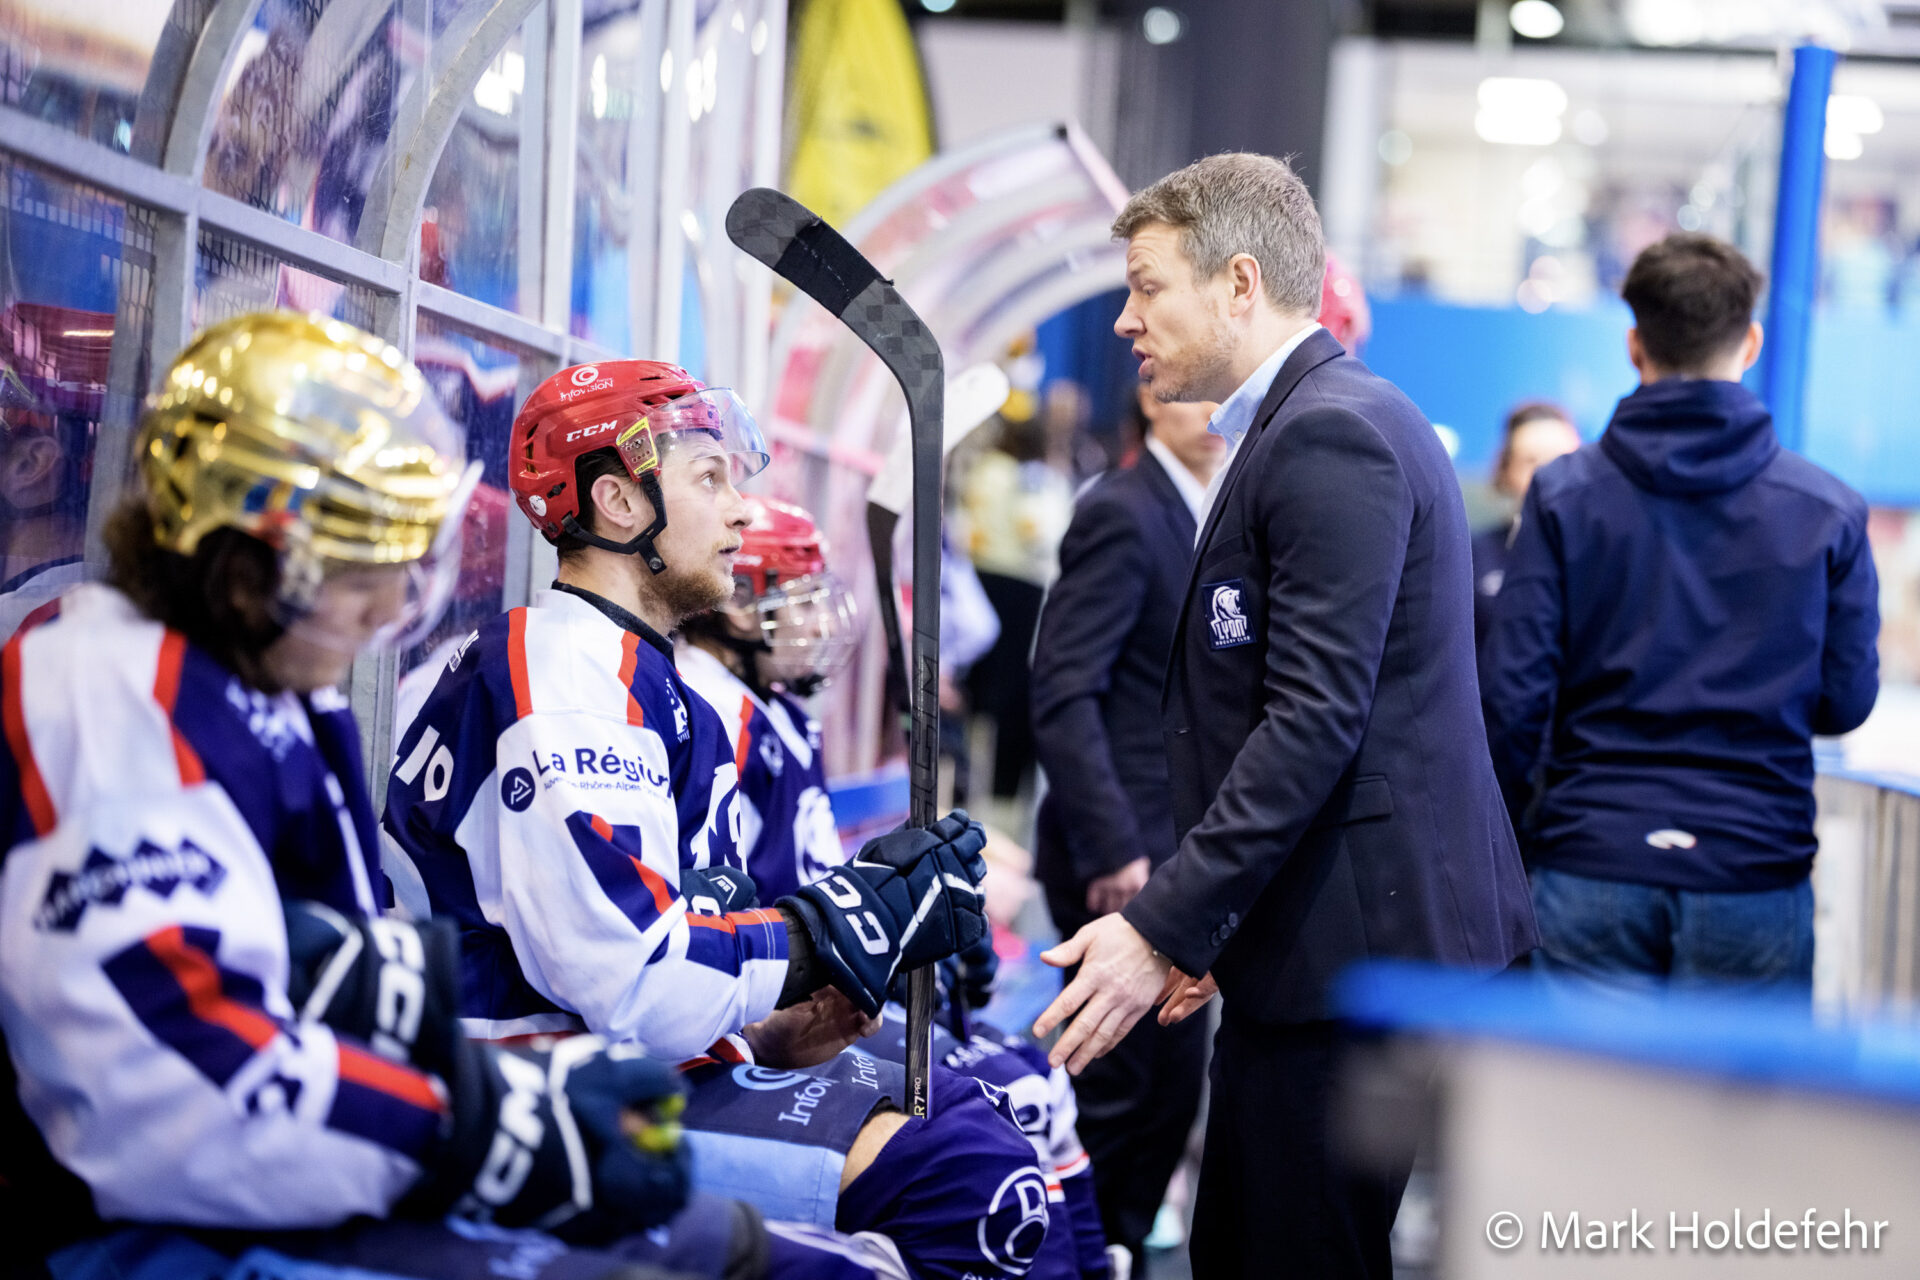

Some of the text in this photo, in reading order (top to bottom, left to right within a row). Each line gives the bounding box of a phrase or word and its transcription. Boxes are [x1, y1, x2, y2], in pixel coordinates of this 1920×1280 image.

[566, 419, 618, 443] CCM
[1215, 619, 1245, 640] LYON
[532, 750, 566, 777] La
[914, 1077, 925, 1119] R7 PRO
